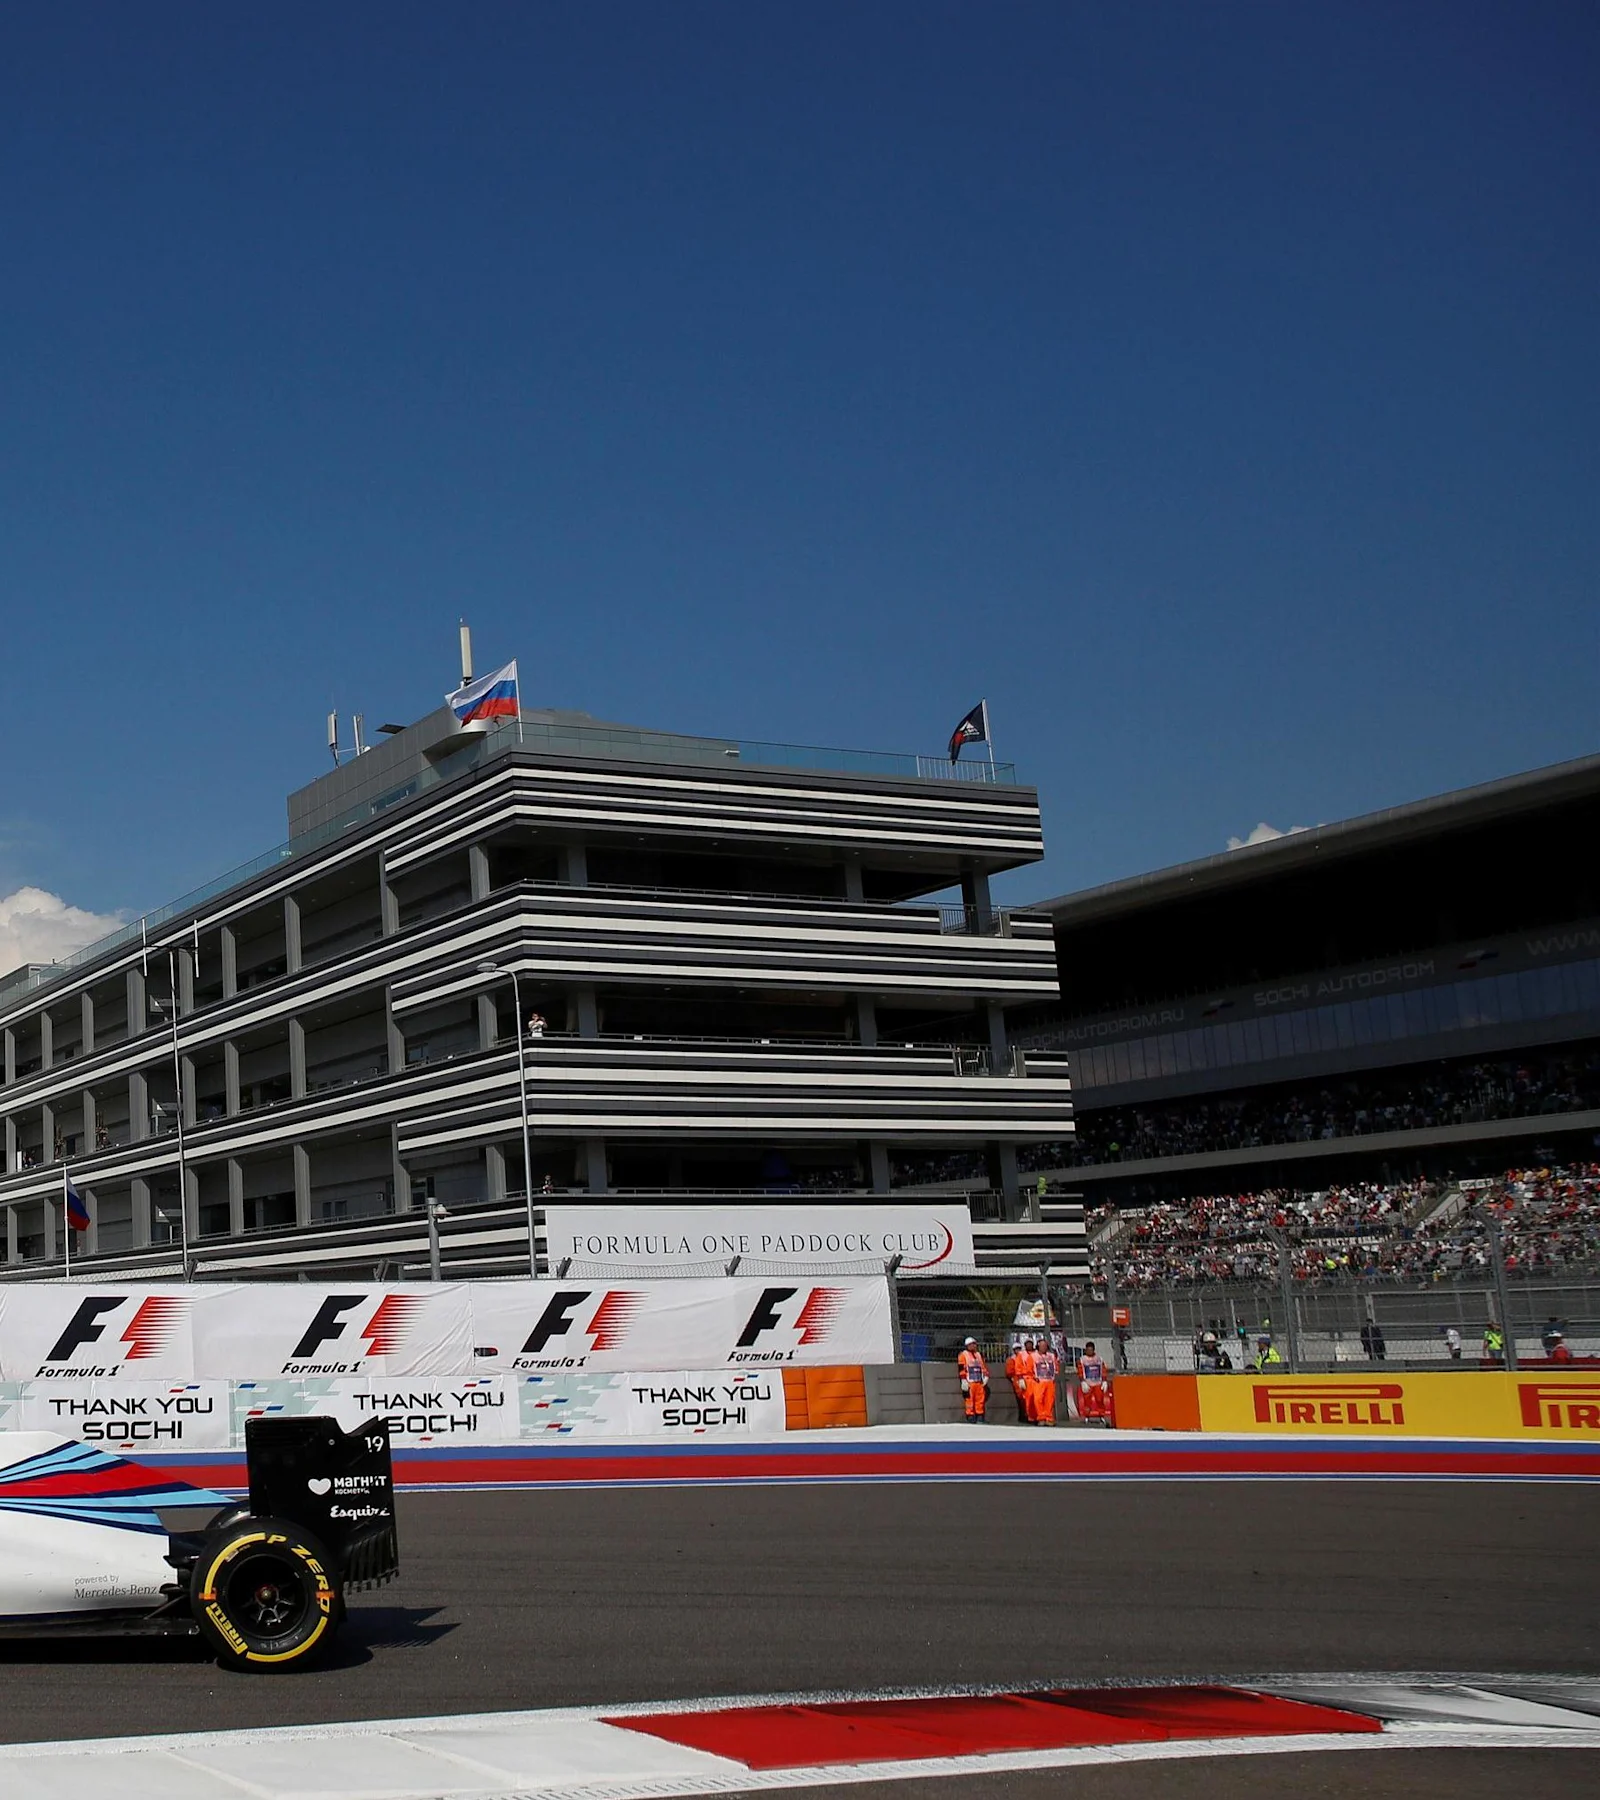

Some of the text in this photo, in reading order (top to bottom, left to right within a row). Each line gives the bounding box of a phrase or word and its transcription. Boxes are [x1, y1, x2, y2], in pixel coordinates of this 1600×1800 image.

[1253, 959, 1435, 1007] SOCHI AUTODROM
[1009, 1009, 1185, 1048] SOCHIAUTODROM.RU
[573, 1234, 939, 1254] FORMULA ONE PADDOCK CLUB
[1113, 1309, 1126, 1323] F
[512, 1356, 587, 1368] Formula 1
[727, 1350, 796, 1361] Formula 1
[35, 1365, 120, 1377] Formula 1
[281, 1361, 361, 1373] Formula 1
[353, 1391, 504, 1410] THANK YOU
[632, 1385, 771, 1403] THANK YOU
[49, 1397, 213, 1415] THANK YOU
[1253, 1384, 1404, 1425] PIRELLI
[388, 1414, 477, 1434] SOCHI
[663, 1406, 746, 1426] SOCHI
[82, 1420, 182, 1440] SOCHI
[365, 1436, 384, 1452] 19
[330, 1505, 390, 1521] Esquire
[75, 1574, 120, 1586] powered by
[266, 1534, 331, 1614] P ZERO
[74, 1584, 157, 1599] Mercedes-Benz
[206, 1602, 249, 1655] PIRELLI
